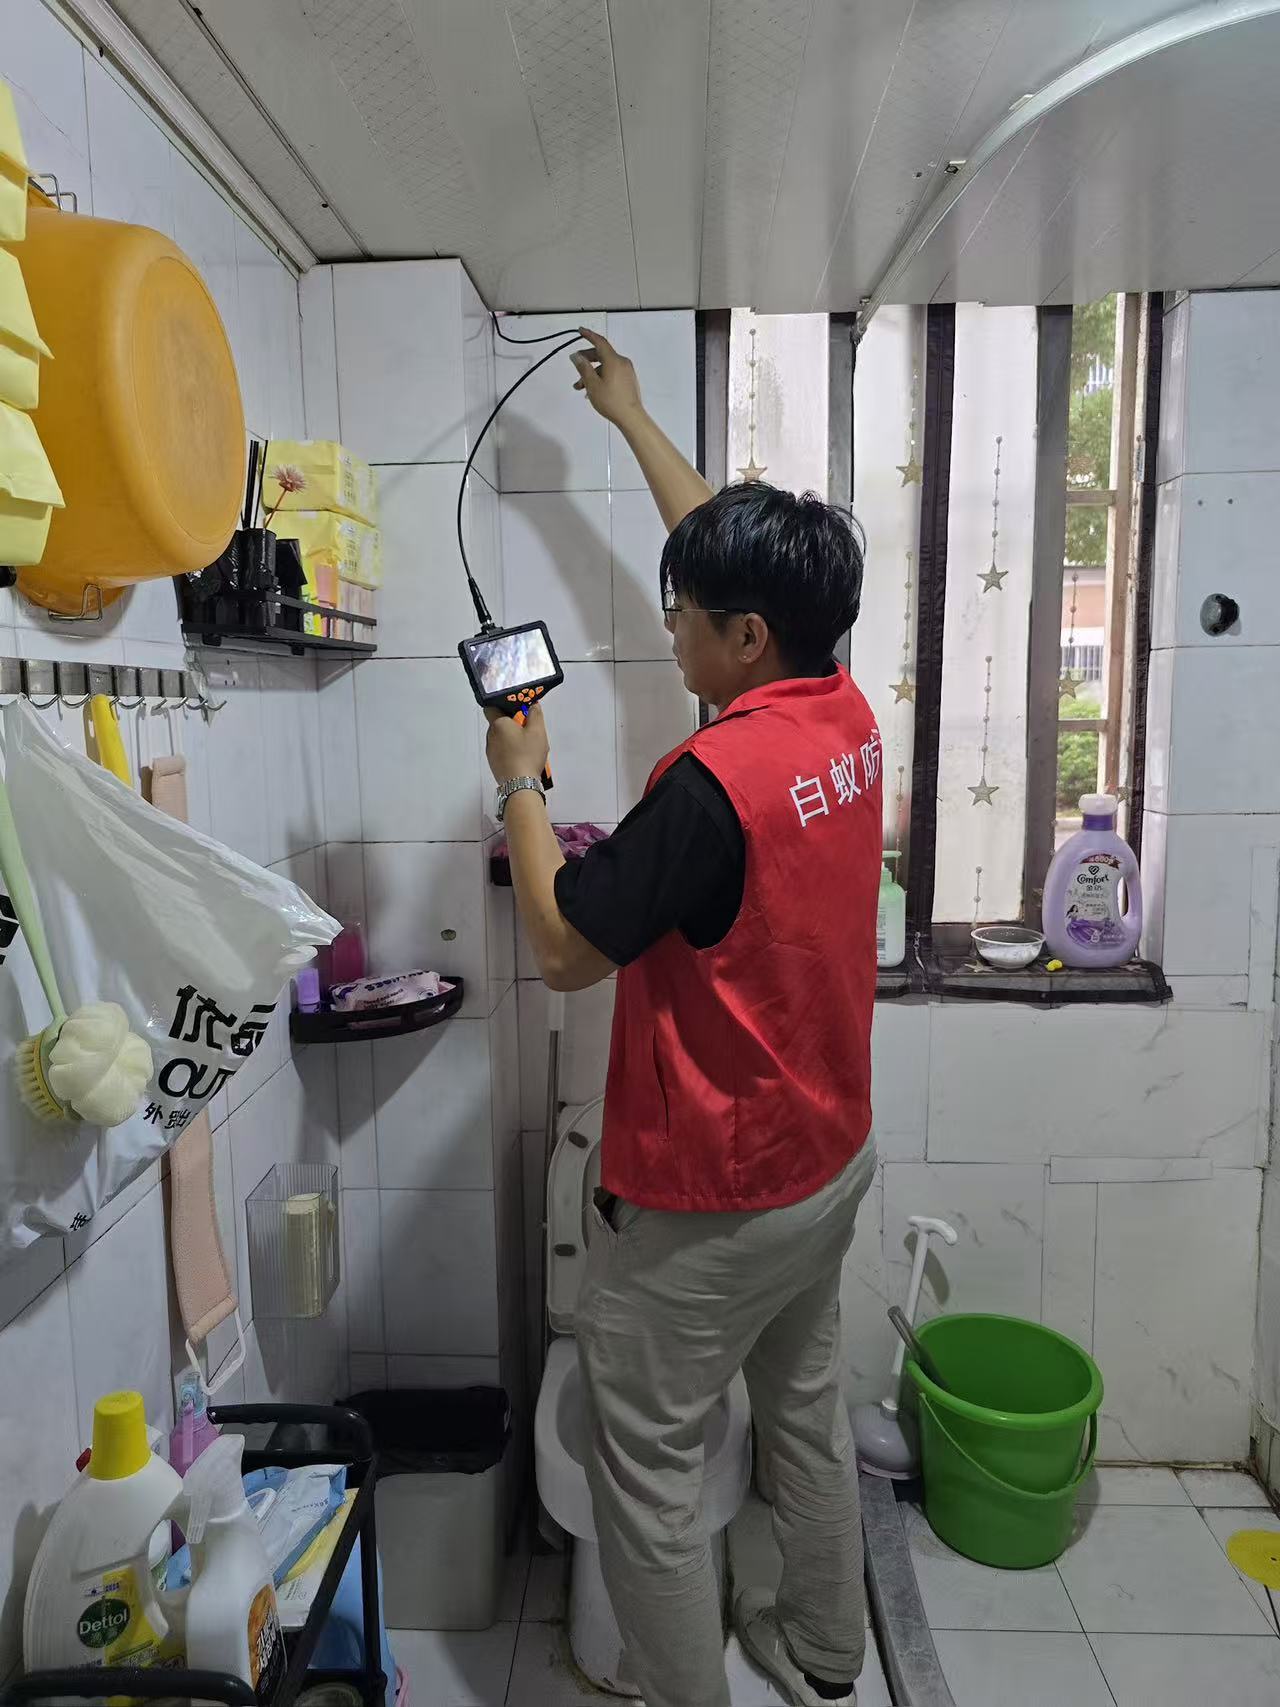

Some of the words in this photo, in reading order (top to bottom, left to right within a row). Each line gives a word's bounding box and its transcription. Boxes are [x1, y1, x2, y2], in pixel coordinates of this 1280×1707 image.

[789, 729, 882, 827] 白蚁防
[1077, 873, 1109, 885] Comfort
[80, 1608, 127, 1635] Dettol
